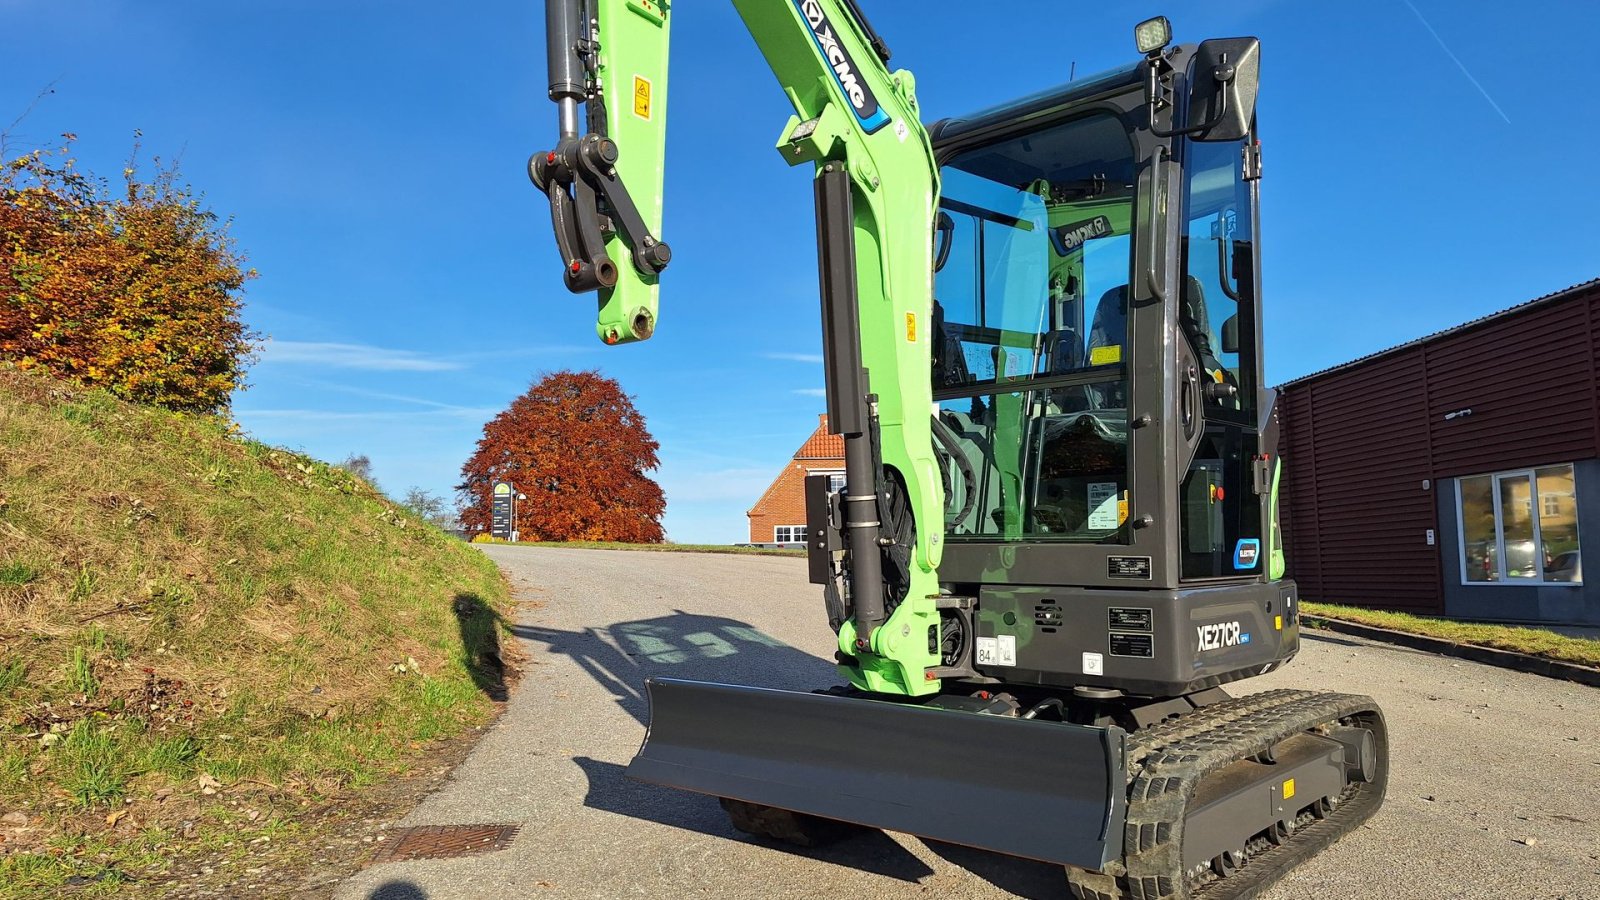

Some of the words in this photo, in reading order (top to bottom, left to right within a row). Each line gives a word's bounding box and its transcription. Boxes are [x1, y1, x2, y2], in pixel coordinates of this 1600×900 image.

[815, 24, 865, 109] XCMG
[1196, 621, 1241, 652] XE27CR
[979, 649, 991, 662] 84
